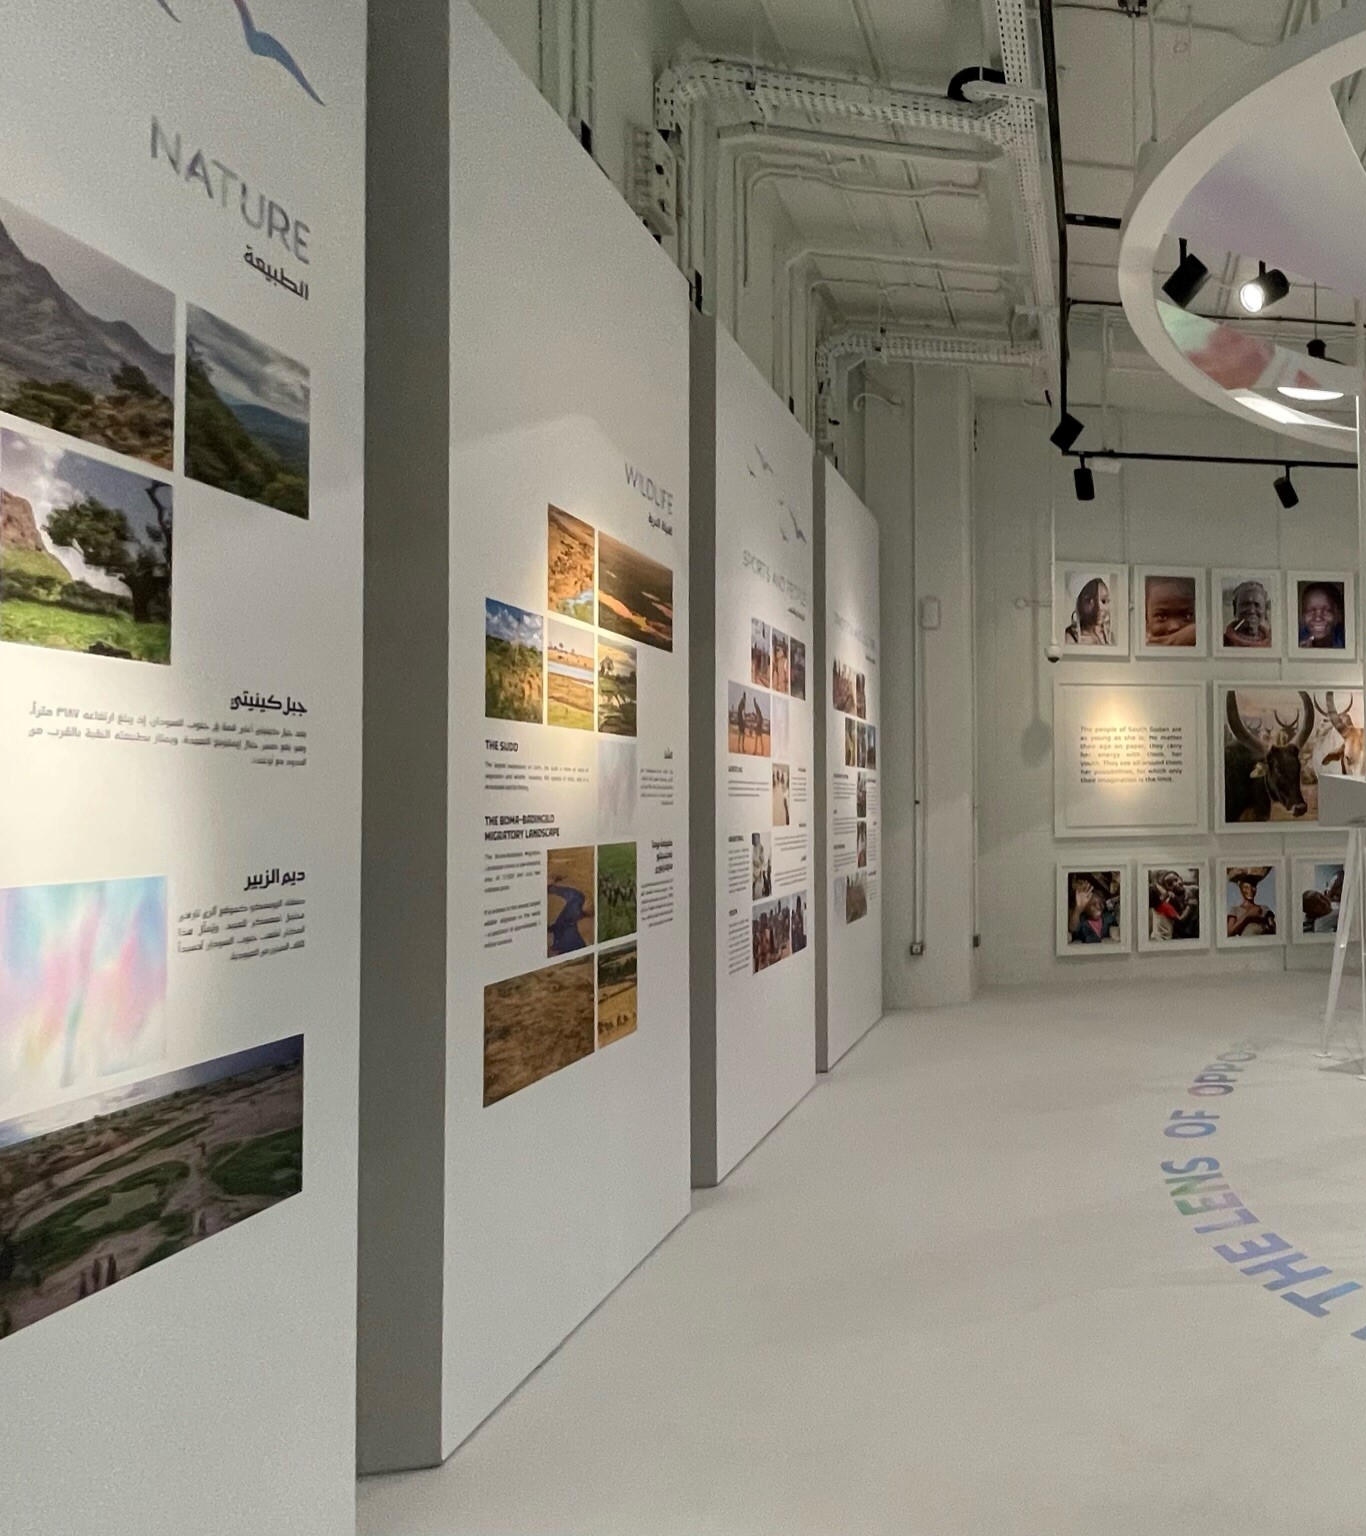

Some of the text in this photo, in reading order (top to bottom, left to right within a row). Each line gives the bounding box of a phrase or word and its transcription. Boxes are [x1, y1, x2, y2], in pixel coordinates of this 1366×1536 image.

[150, 115, 311, 264] NATURE
[243, 244, 310, 301] الطبيعة
[624, 460, 674, 515] WILDLIFE
[230, 690, 308, 717] جبل كينيتي
[484, 738, 499, 752] THE
[484, 815, 498, 827] THE
[484, 827, 560, 842] MIGRATORY LANDSCAPE
[244, 868, 306, 891] ديم الزبير
[1163, 1109, 1220, 1139] OF
[1160, 1156, 1260, 1234] LENS
[1212, 1231, 1364, 1318] THE
